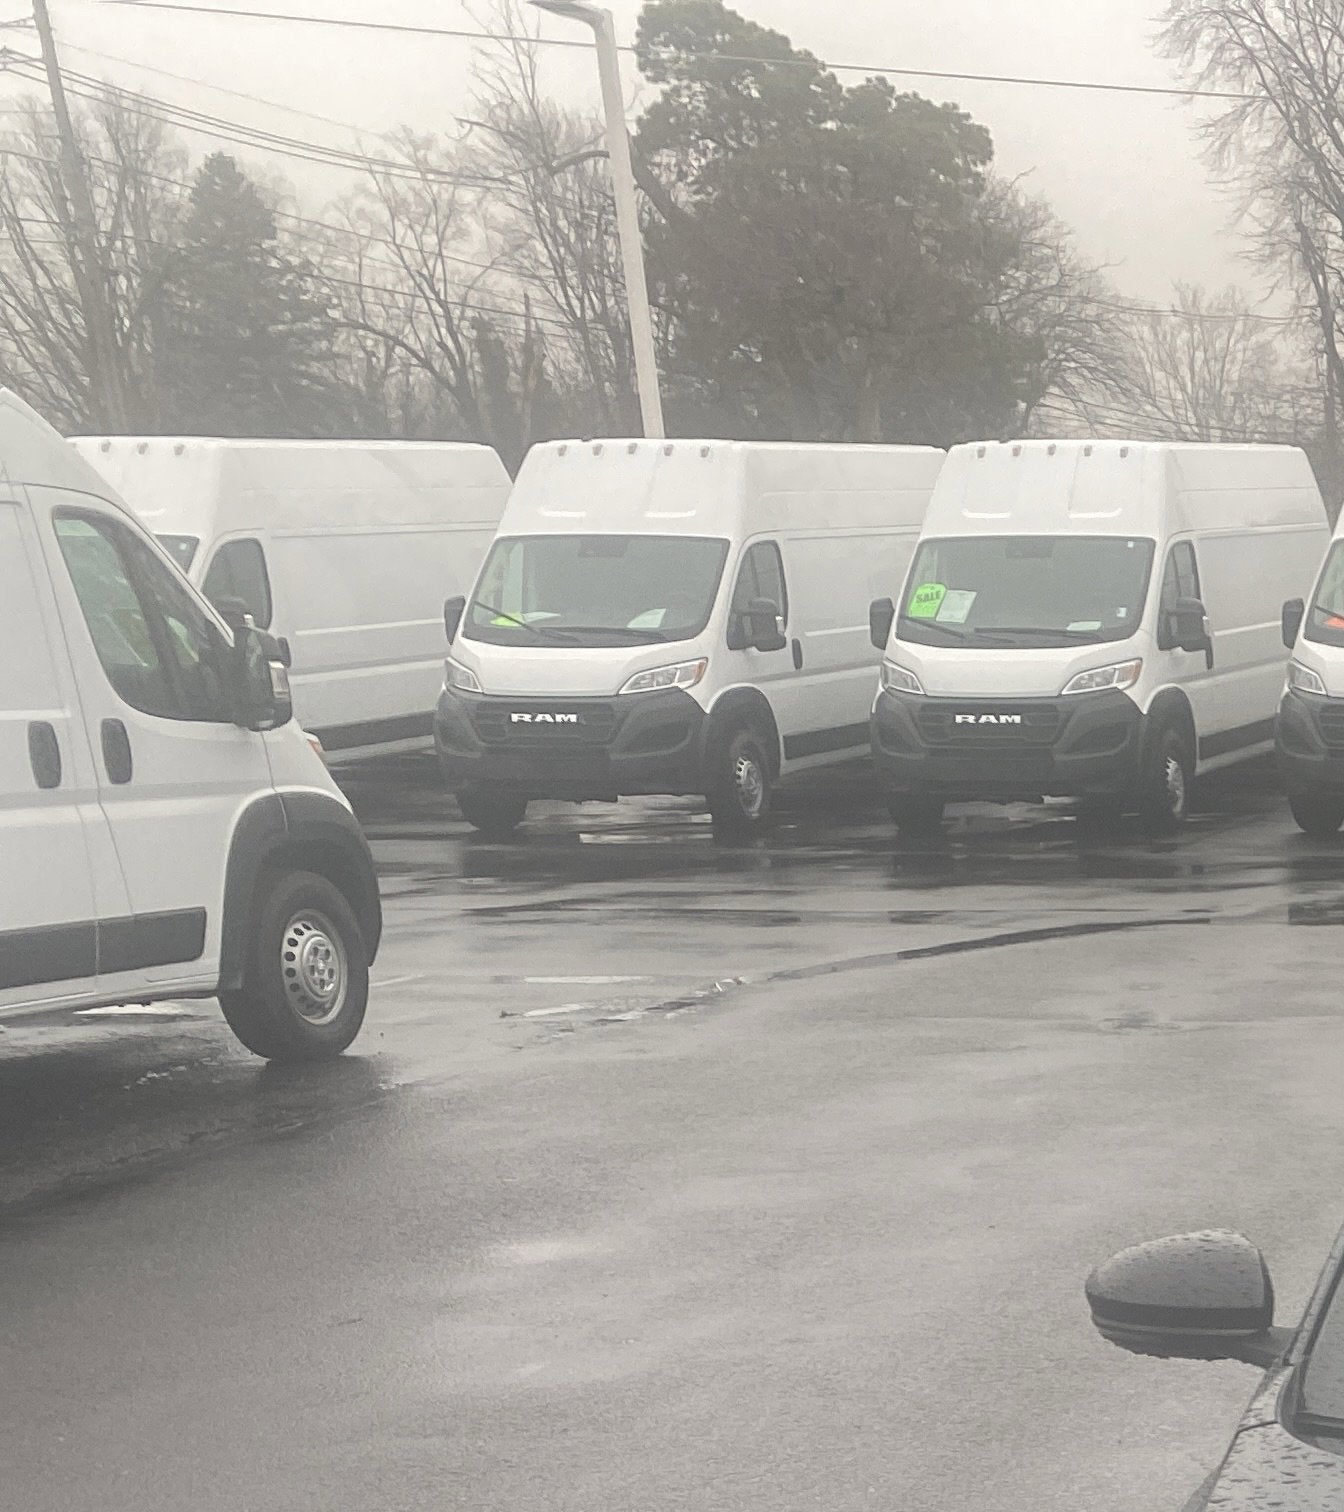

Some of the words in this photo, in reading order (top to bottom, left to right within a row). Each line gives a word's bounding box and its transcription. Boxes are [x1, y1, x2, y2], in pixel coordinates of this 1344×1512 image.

[916, 590, 941, 603] SALE
[511, 713, 577, 722] RAM
[955, 714, 1022, 724] RAM
